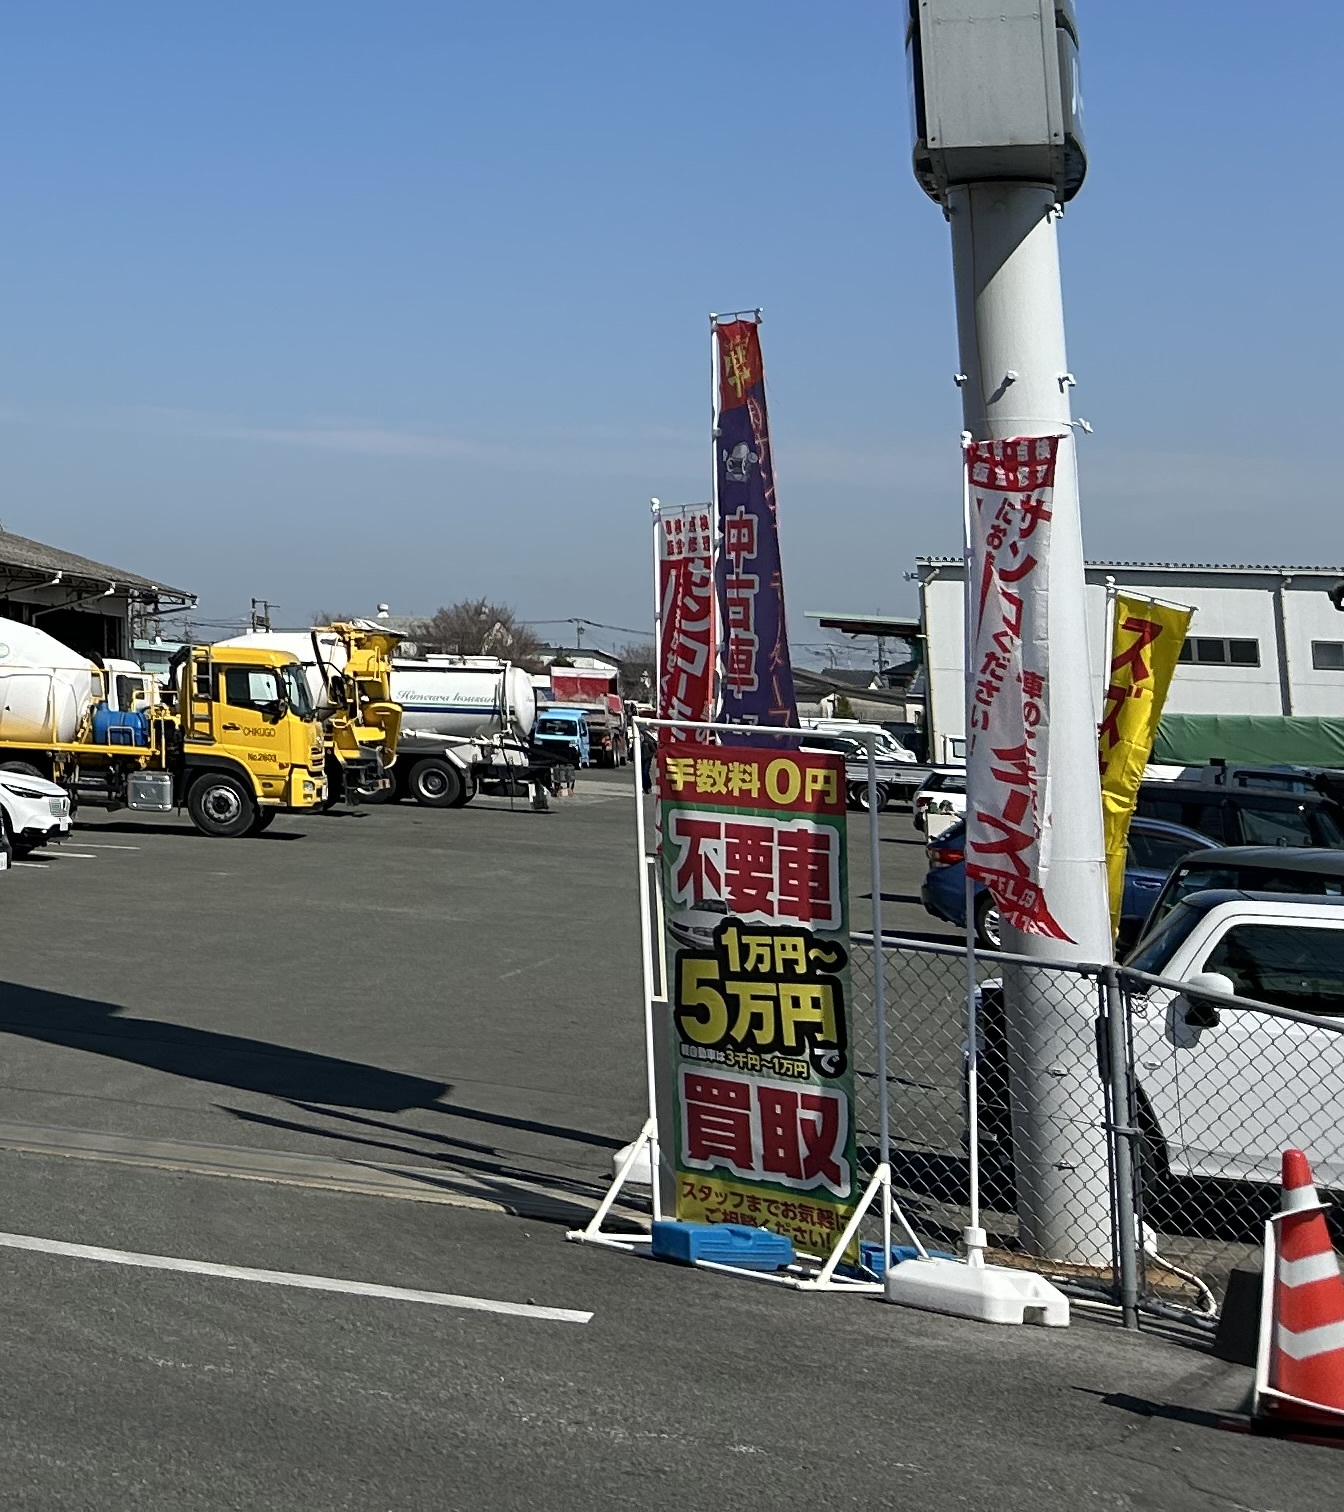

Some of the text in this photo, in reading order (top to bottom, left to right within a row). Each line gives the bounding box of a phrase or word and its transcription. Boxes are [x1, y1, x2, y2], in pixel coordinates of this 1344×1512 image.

[242, 727, 276, 737] CHIKUGO
[666, 757, 838, 805] 手数料0円
[675, 818, 833, 922] 不要車
[680, 959, 838, 1047] 5万円
[814, 1048, 840, 1074] で
[684, 1072, 842, 1188] 買取
